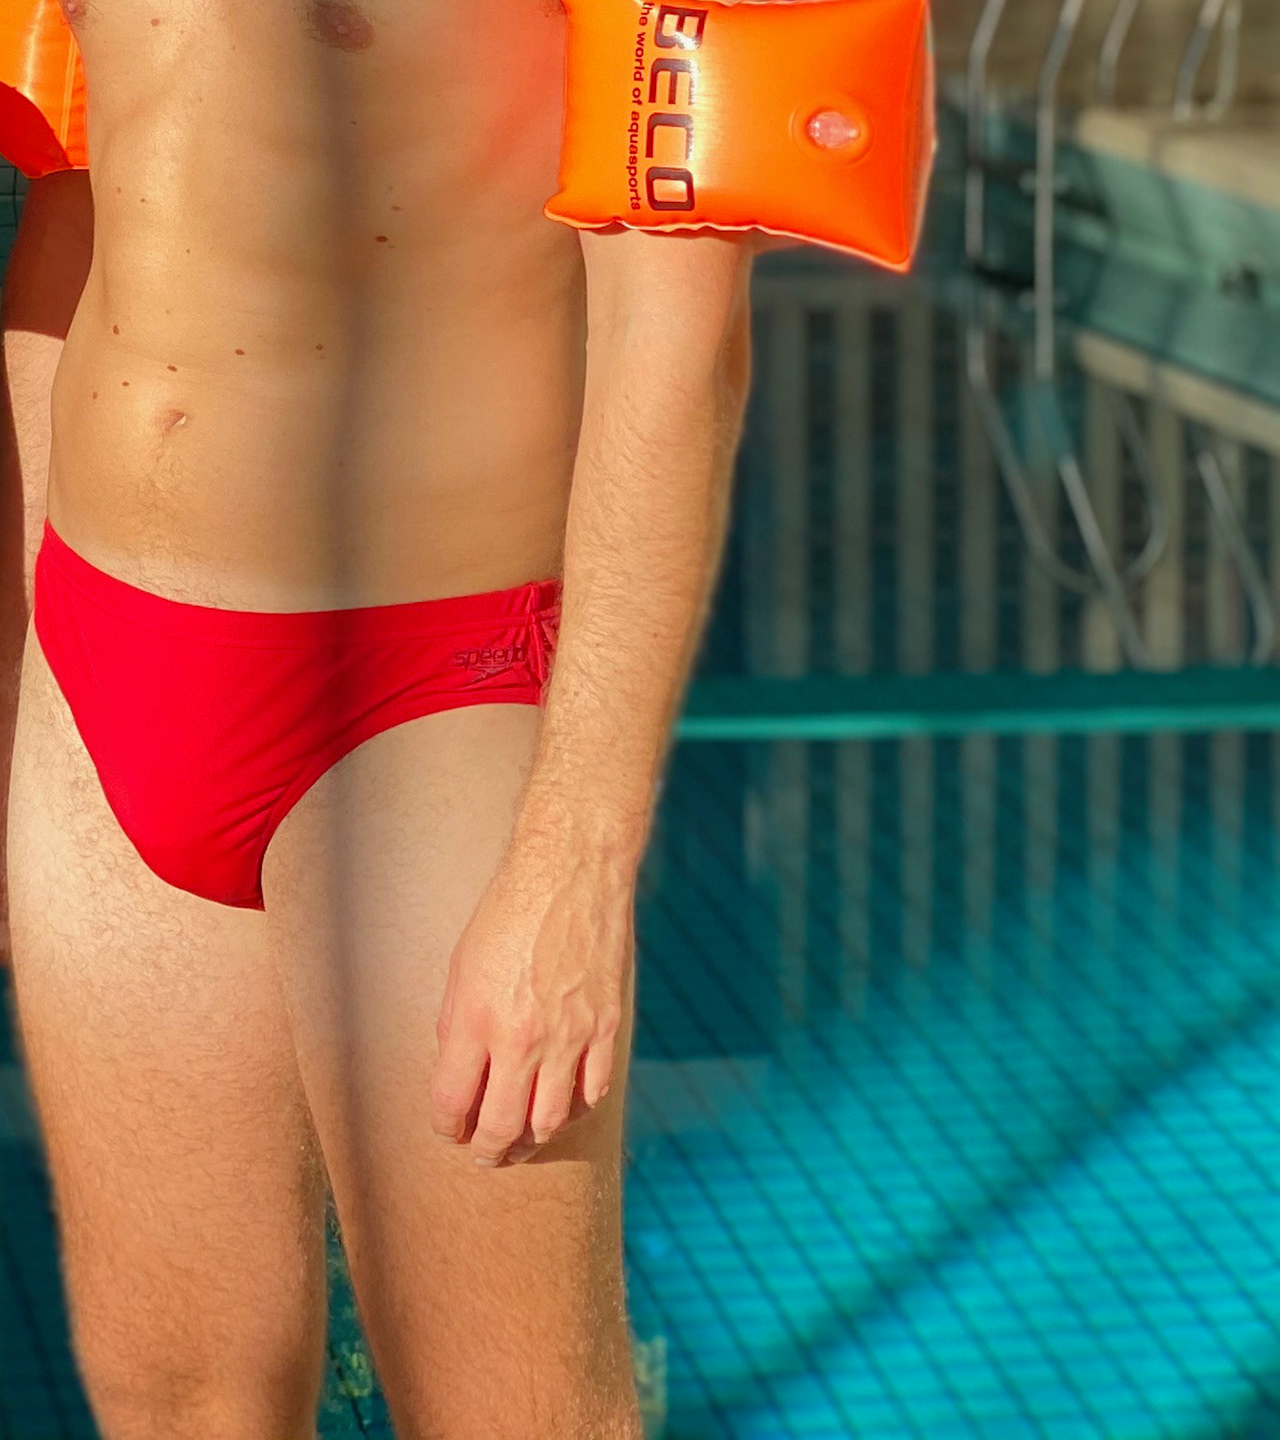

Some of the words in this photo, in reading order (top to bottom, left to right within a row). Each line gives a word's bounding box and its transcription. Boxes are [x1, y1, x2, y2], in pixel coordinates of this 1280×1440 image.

[639, 1, 656, 27] the
[633, 31, 646, 82] world
[631, 86, 643, 107] of
[645, 4, 709, 212] BECO
[626, 110, 642, 211] aquasports
